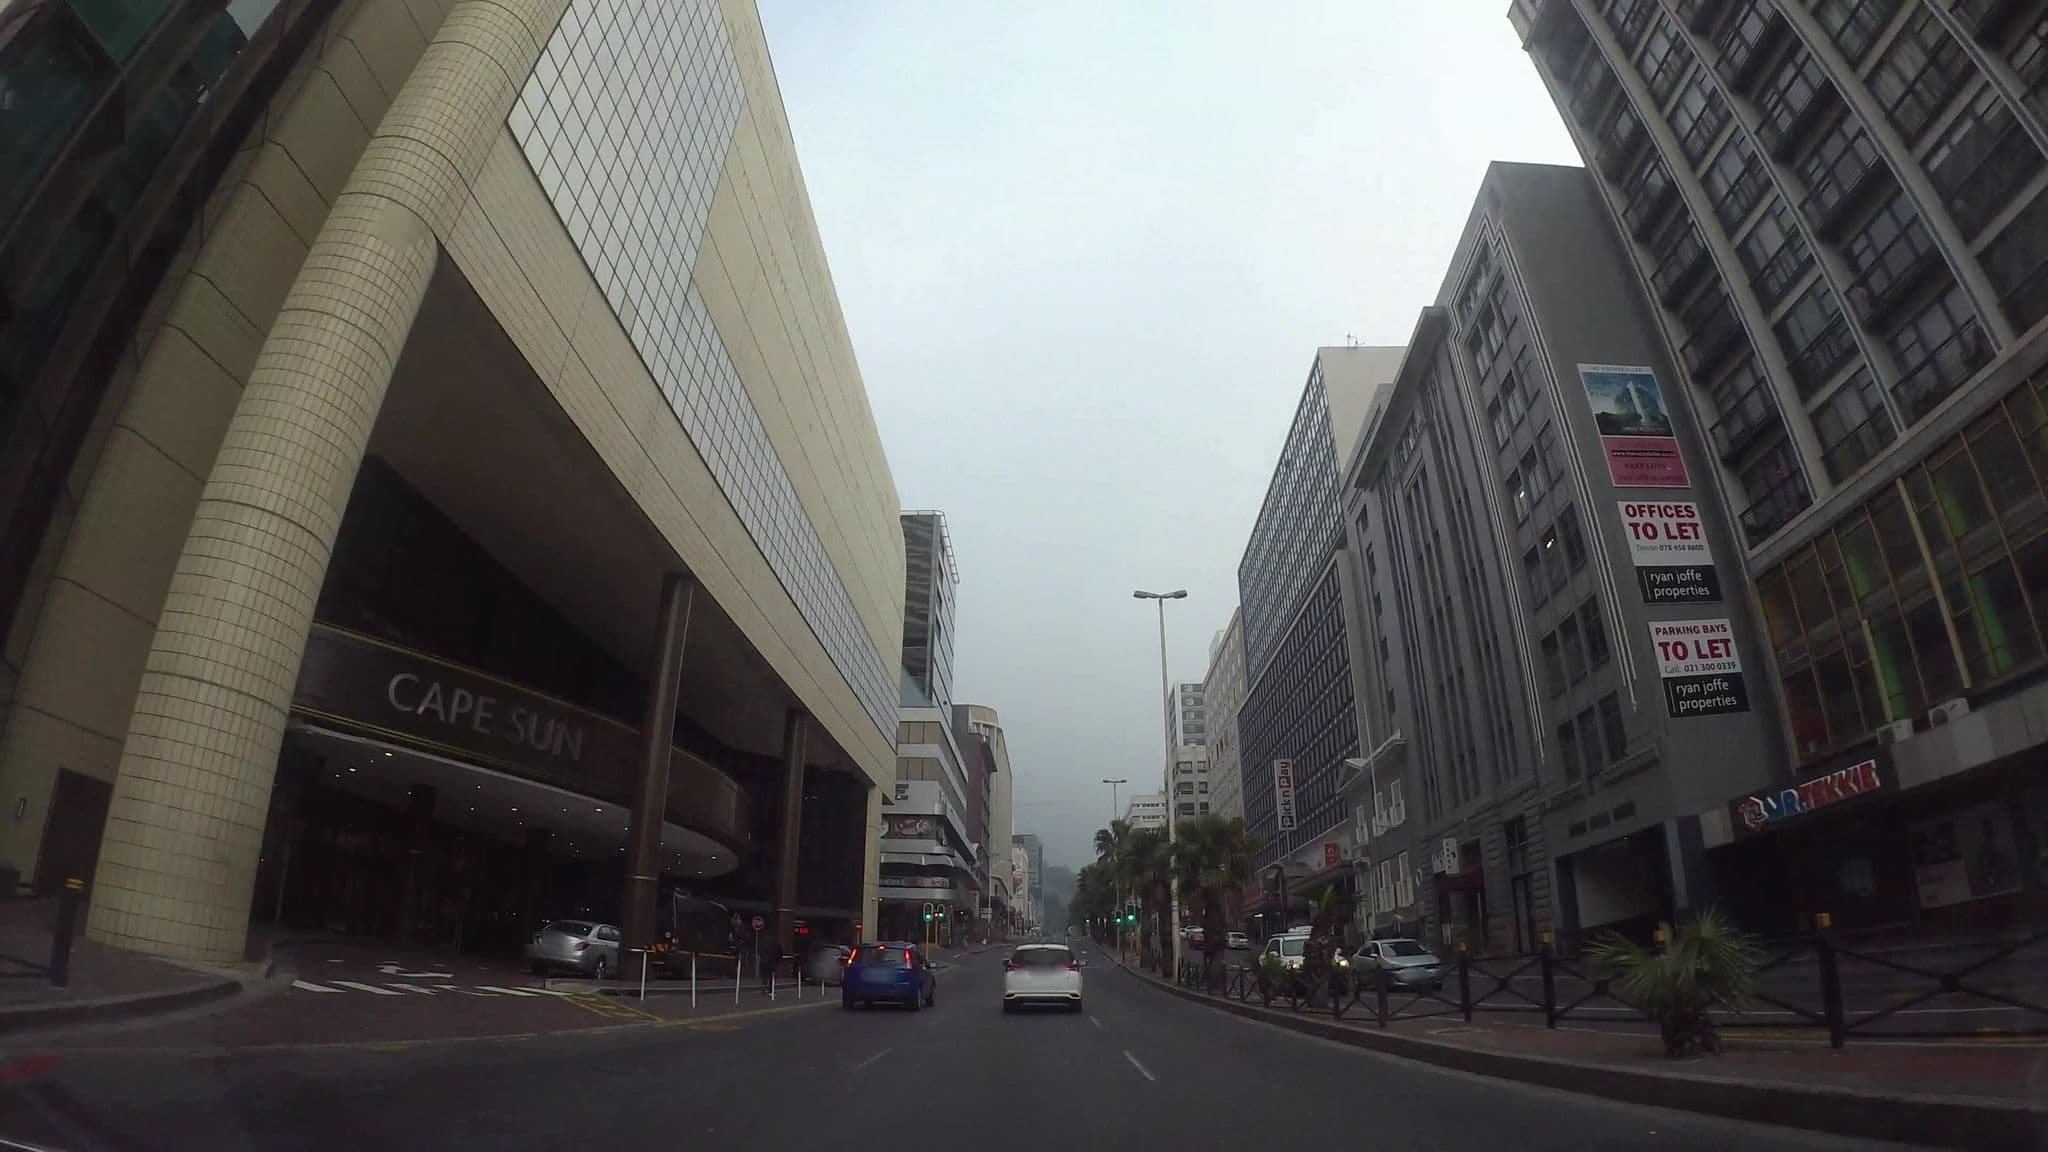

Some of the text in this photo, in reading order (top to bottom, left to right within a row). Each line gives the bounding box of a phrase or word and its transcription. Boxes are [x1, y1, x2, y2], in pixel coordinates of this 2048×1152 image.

[1624, 504, 1696, 519] OFFICES
[1628, 522, 1701, 541] TO LET
[1650, 568, 1703, 585] ryan joffe
[1653, 584, 1711, 600] properties
[1655, 623, 1728, 637] PARKING BAYS
[1657, 638, 1732, 662] TO LET
[1684, 664, 1699, 673] 021
[1700, 662, 1716, 672] 300
[1676, 680, 1730, 696] ryan joffe
[1679, 695, 1737, 713] properties
[388, 673, 583, 761] CAPE SUN
[1279, 761, 1294, 828] Pick n Pay
